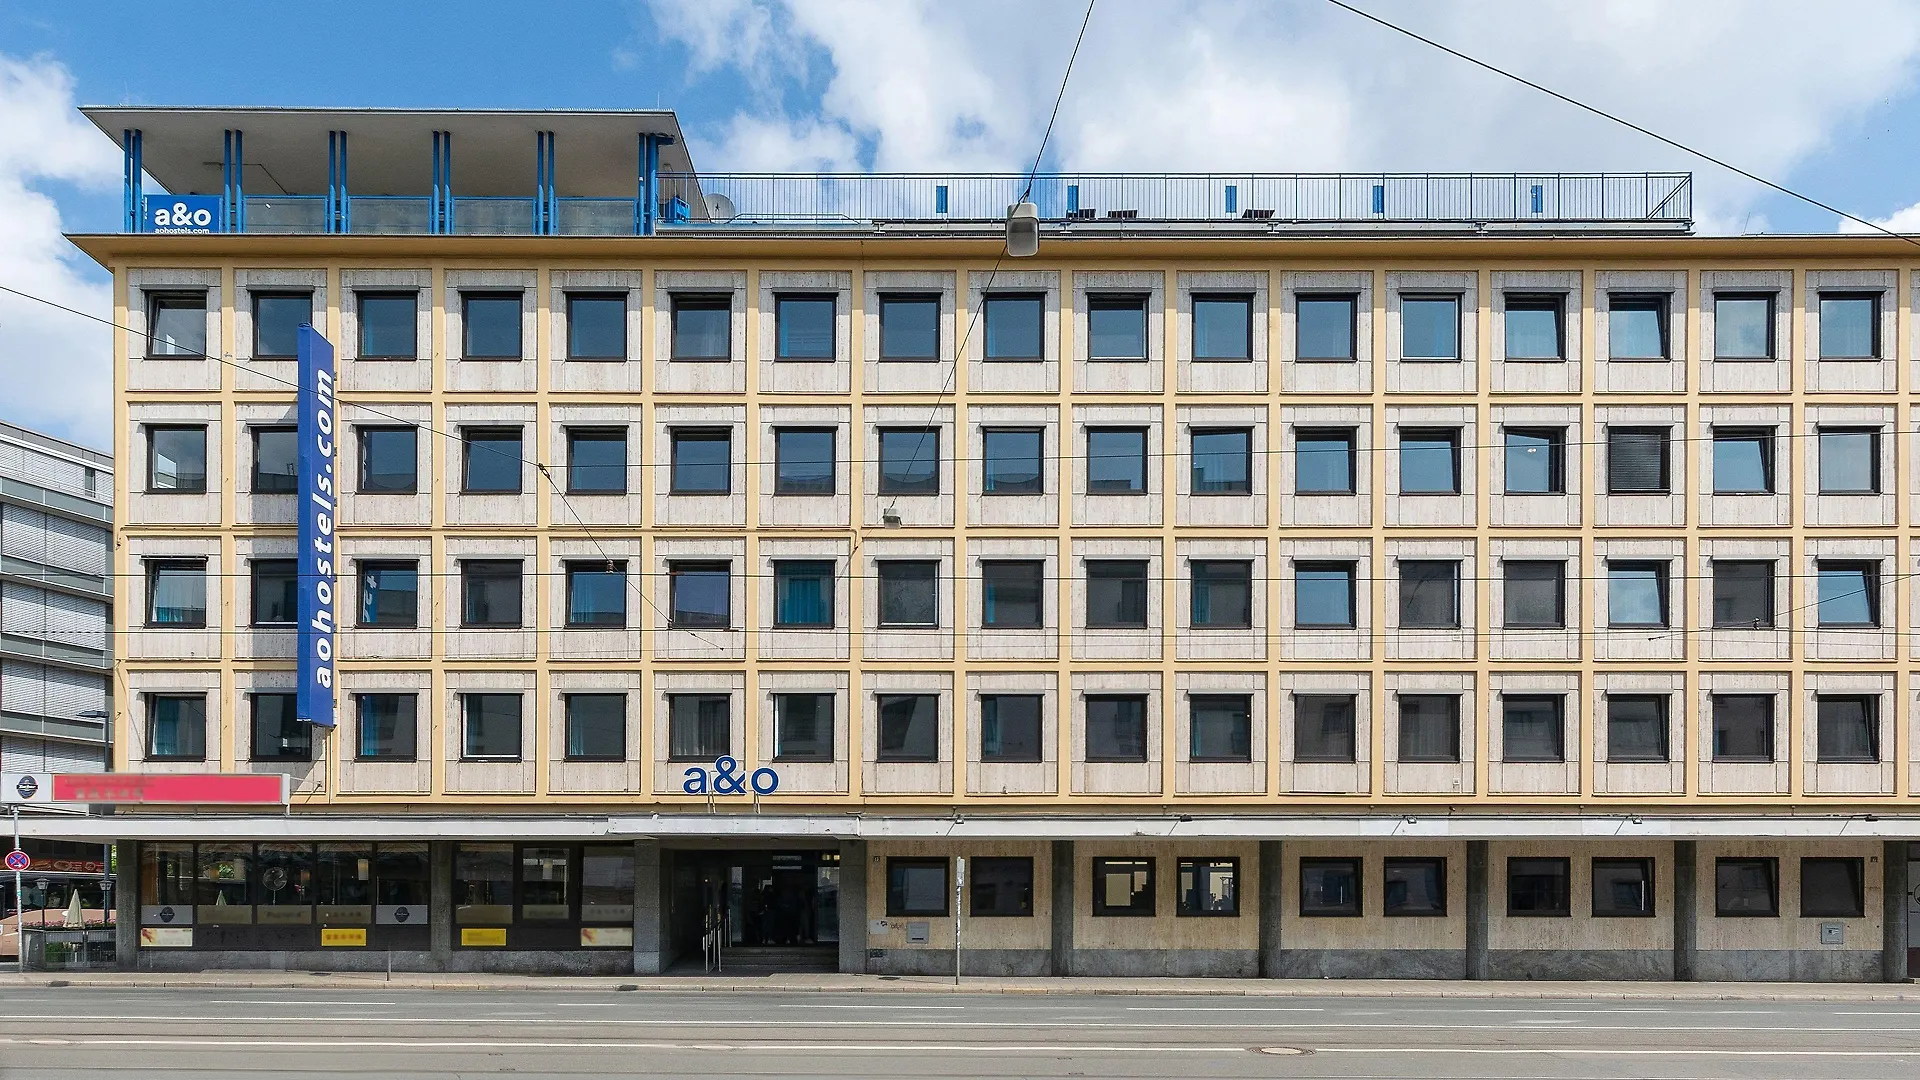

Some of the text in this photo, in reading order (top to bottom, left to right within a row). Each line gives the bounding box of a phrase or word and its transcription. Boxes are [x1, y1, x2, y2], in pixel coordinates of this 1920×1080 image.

[155, 203, 211, 226] a&o
[312, 369, 332, 689] aohostels.com
[683, 755, 779, 795] a&o
